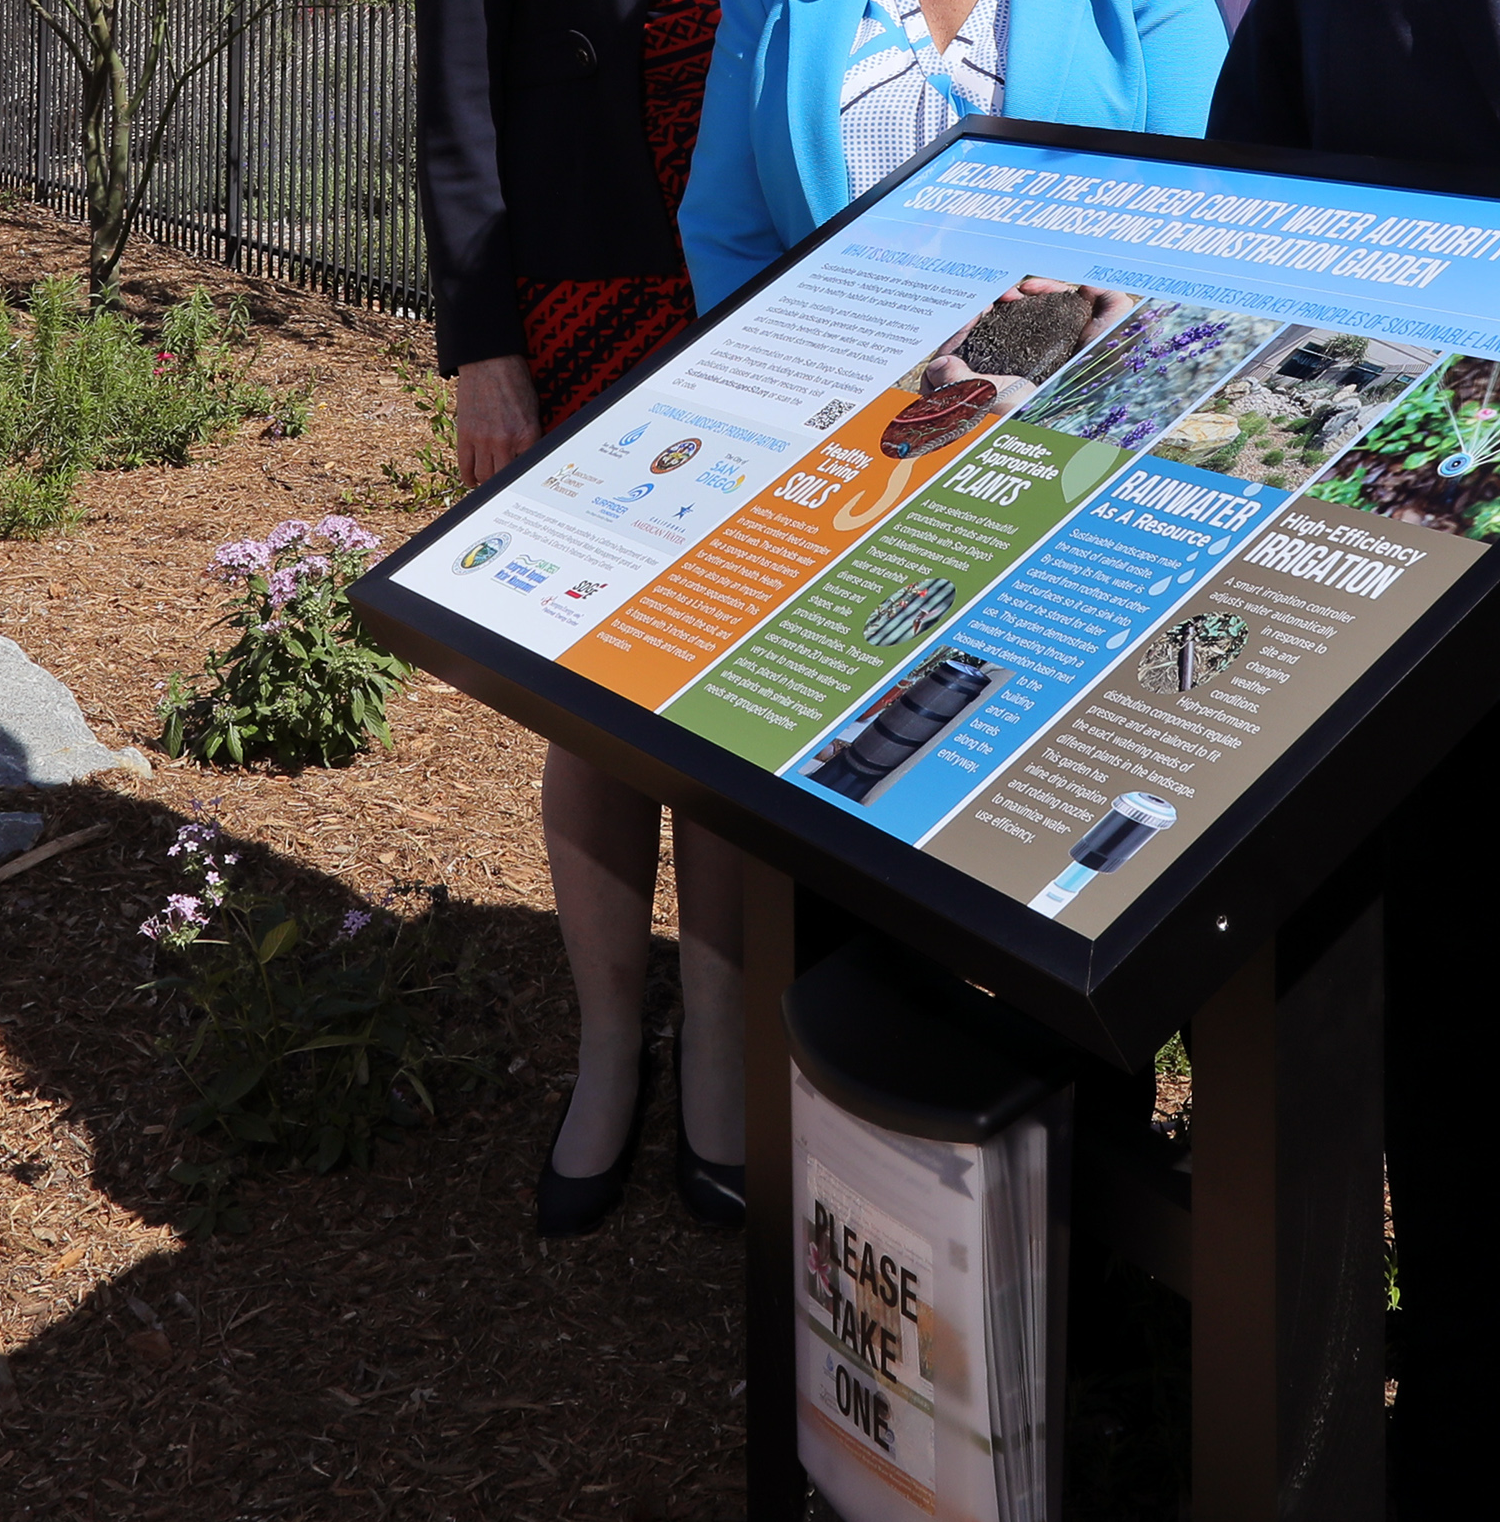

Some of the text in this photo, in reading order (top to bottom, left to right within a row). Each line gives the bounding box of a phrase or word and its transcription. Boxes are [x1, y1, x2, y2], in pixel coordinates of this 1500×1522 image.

[935, 161, 1037, 193] WELCOME
[1019, 171, 1060, 196] TO
[1045, 175, 1102, 202] THE
[1083, 180, 1145, 208] SAN
[1125, 185, 1206, 216] DIEGO
[1190, 194, 1298, 229] COUNTY
[1279, 205, 1377, 241] WATER
[903, 186, 1452, 289] SUSTAINABLE LANDSCAPING DEMONSTRATION GARDEN
[840, 243, 1009, 284] WHAT IS SUSTAINABLE LANDSCAPING?
[1083, 265, 1115, 282] THIS
[1105, 269, 1157, 289] GARDEN
[1147, 276, 1244, 305] DEMONSTRATES
[1234, 291, 1275, 310] FOUR
[1266, 297, 1302, 315] KEY
[1291, 301, 1371, 327] PRINCIPLES
[1362, 314, 1391, 330] OF
[1381, 317, 1481, 347] SUSTAINABLE
[647, 402, 791, 453] SUSTAINABLE LANDSCAPES PROGRAM PARTNERS
[992, 434, 1052, 463] Climate-
[709, 460, 741, 477] SAN
[816, 457, 864, 483] Living
[820, 441, 874, 470] Healthy,
[975, 447, 1059, 480] Appropriate
[695, 471, 740, 494] DIEGO
[773, 471, 842, 509] SOILS
[942, 463, 1032, 506] PLANTS
[1110, 470, 1262, 532] RAINWATER
[591, 496, 629, 515] SURFRIDER
[749, 504, 820, 535] Healthy, living soils rich
[920, 498, 1019, 535] A large selection of beautiful
[1089, 501, 1212, 547] As A Resource
[630, 519, 686, 546] AMERICAN WATER
[905, 511, 1011, 551] groundcovers, shrubs and trees
[1068, 528, 1182, 570] Sustainable landscapes make
[1279, 512, 1428, 567] High-Efficiency
[1040, 553, 1145, 595] By slowing its flow, water is
[1054, 540, 1153, 579] the most of rainfall onsite.
[1242, 531, 1405, 600] IRRIGATION
[1026, 567, 1151, 614] captured from rooftops and other
[1223, 576, 1356, 624] A smart irrigation controller
[1209, 591, 1338, 640] adjusts water automatically
[1259, 645, 1301, 665] site and
[1260, 624, 1328, 655] in response to
[1230, 676, 1272, 696] weather
[1245, 661, 1291, 684] changing
[1103, 689, 1242, 749] distribution components regulate
[1175, 695, 1261, 735] High-performance
[1210, 689, 1260, 714] conditions.
[1071, 717, 1195, 773] the exact watering needs of
[1085, 705, 1222, 763] pressure and are tailored to fit
[1023, 761, 1108, 806] inline drip irrigation
[1041, 746, 1109, 783] This garden has
[1055, 733, 1195, 799] different plants in the landscape.
[991, 792, 1072, 834] to maximize water-
[1007, 779, 1095, 823] and rotating nozzles
[974, 809, 1036, 844] use efficiency.
[815, 1199, 917, 1324] PLEASE
[829, 1287, 897, 1384] TAKE
[835, 1364, 890, 1452] ONE
